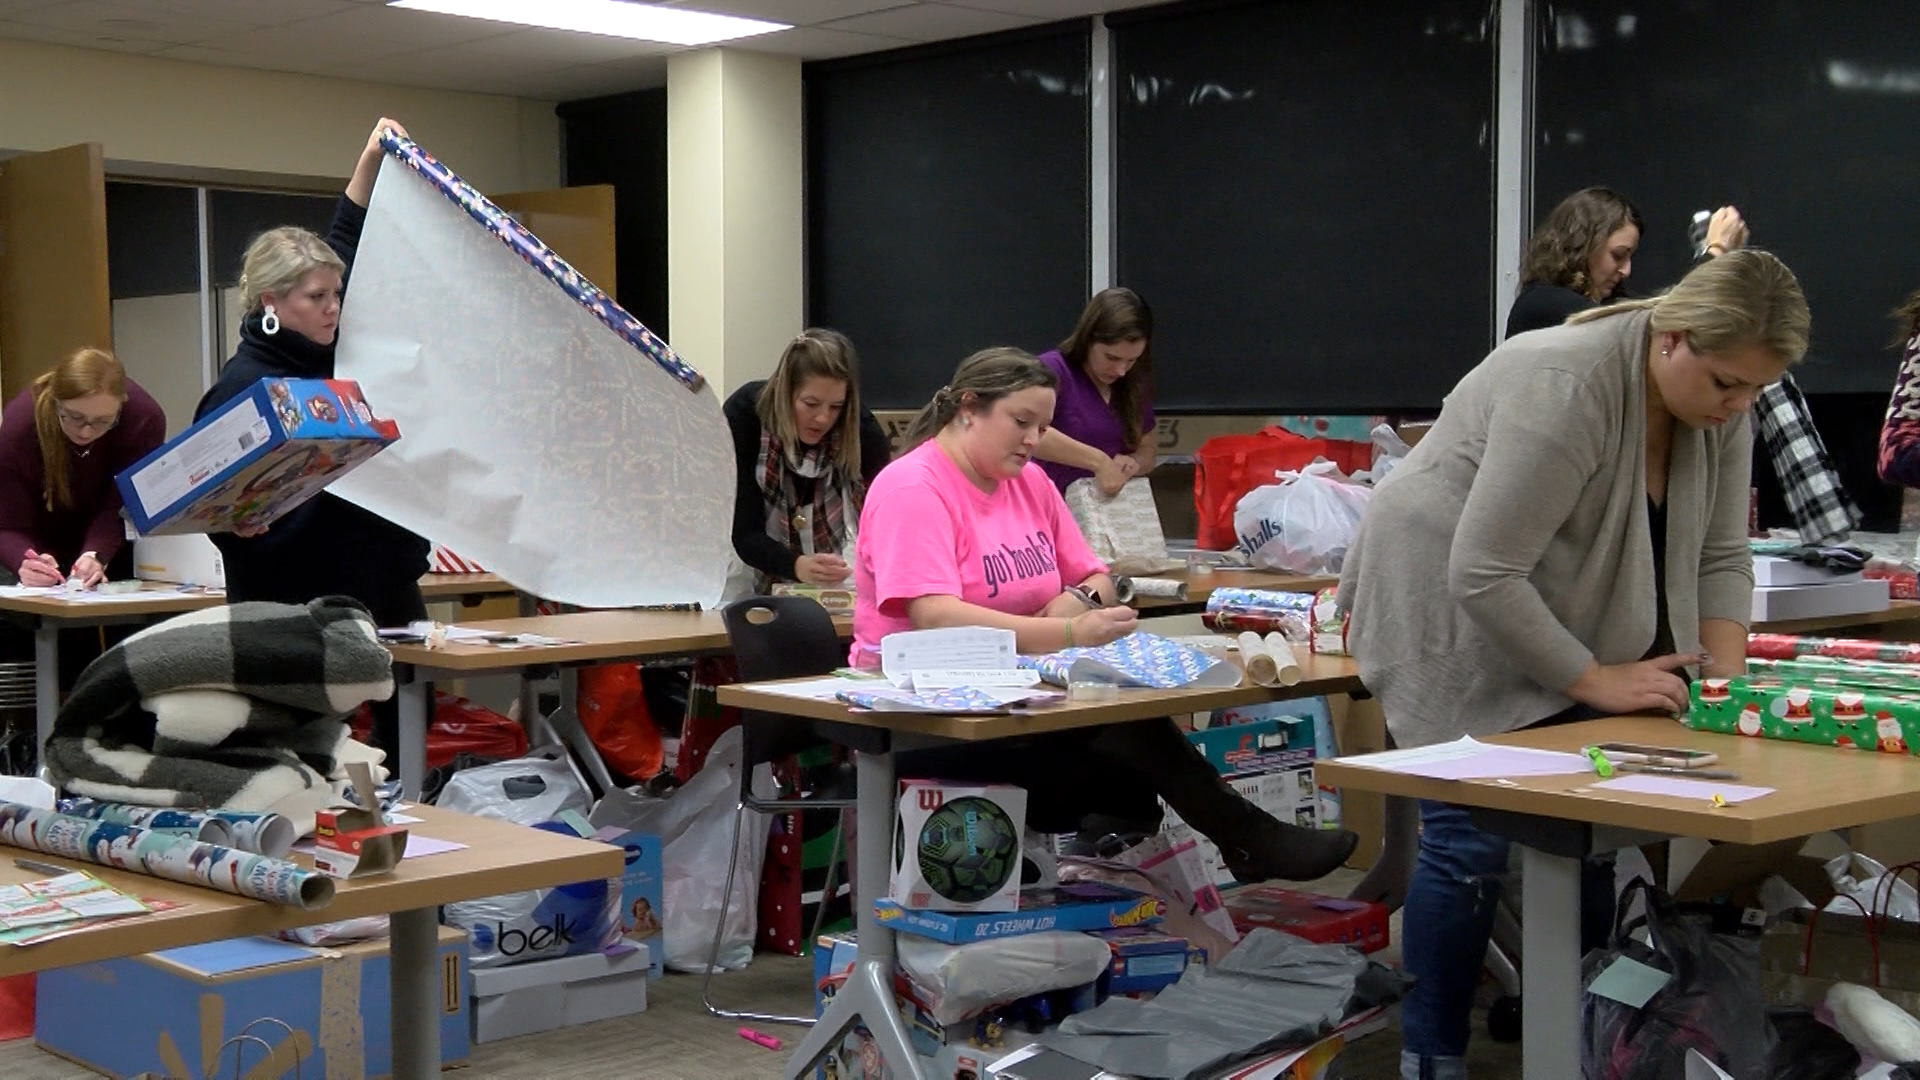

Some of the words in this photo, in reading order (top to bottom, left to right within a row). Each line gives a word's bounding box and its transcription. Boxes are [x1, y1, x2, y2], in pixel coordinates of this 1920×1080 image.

[983, 549, 1014, 598] got
[498, 913, 577, 956] belk
[990, 917, 1035, 935] WHEELS
[1034, 915, 1057, 930] HOT
